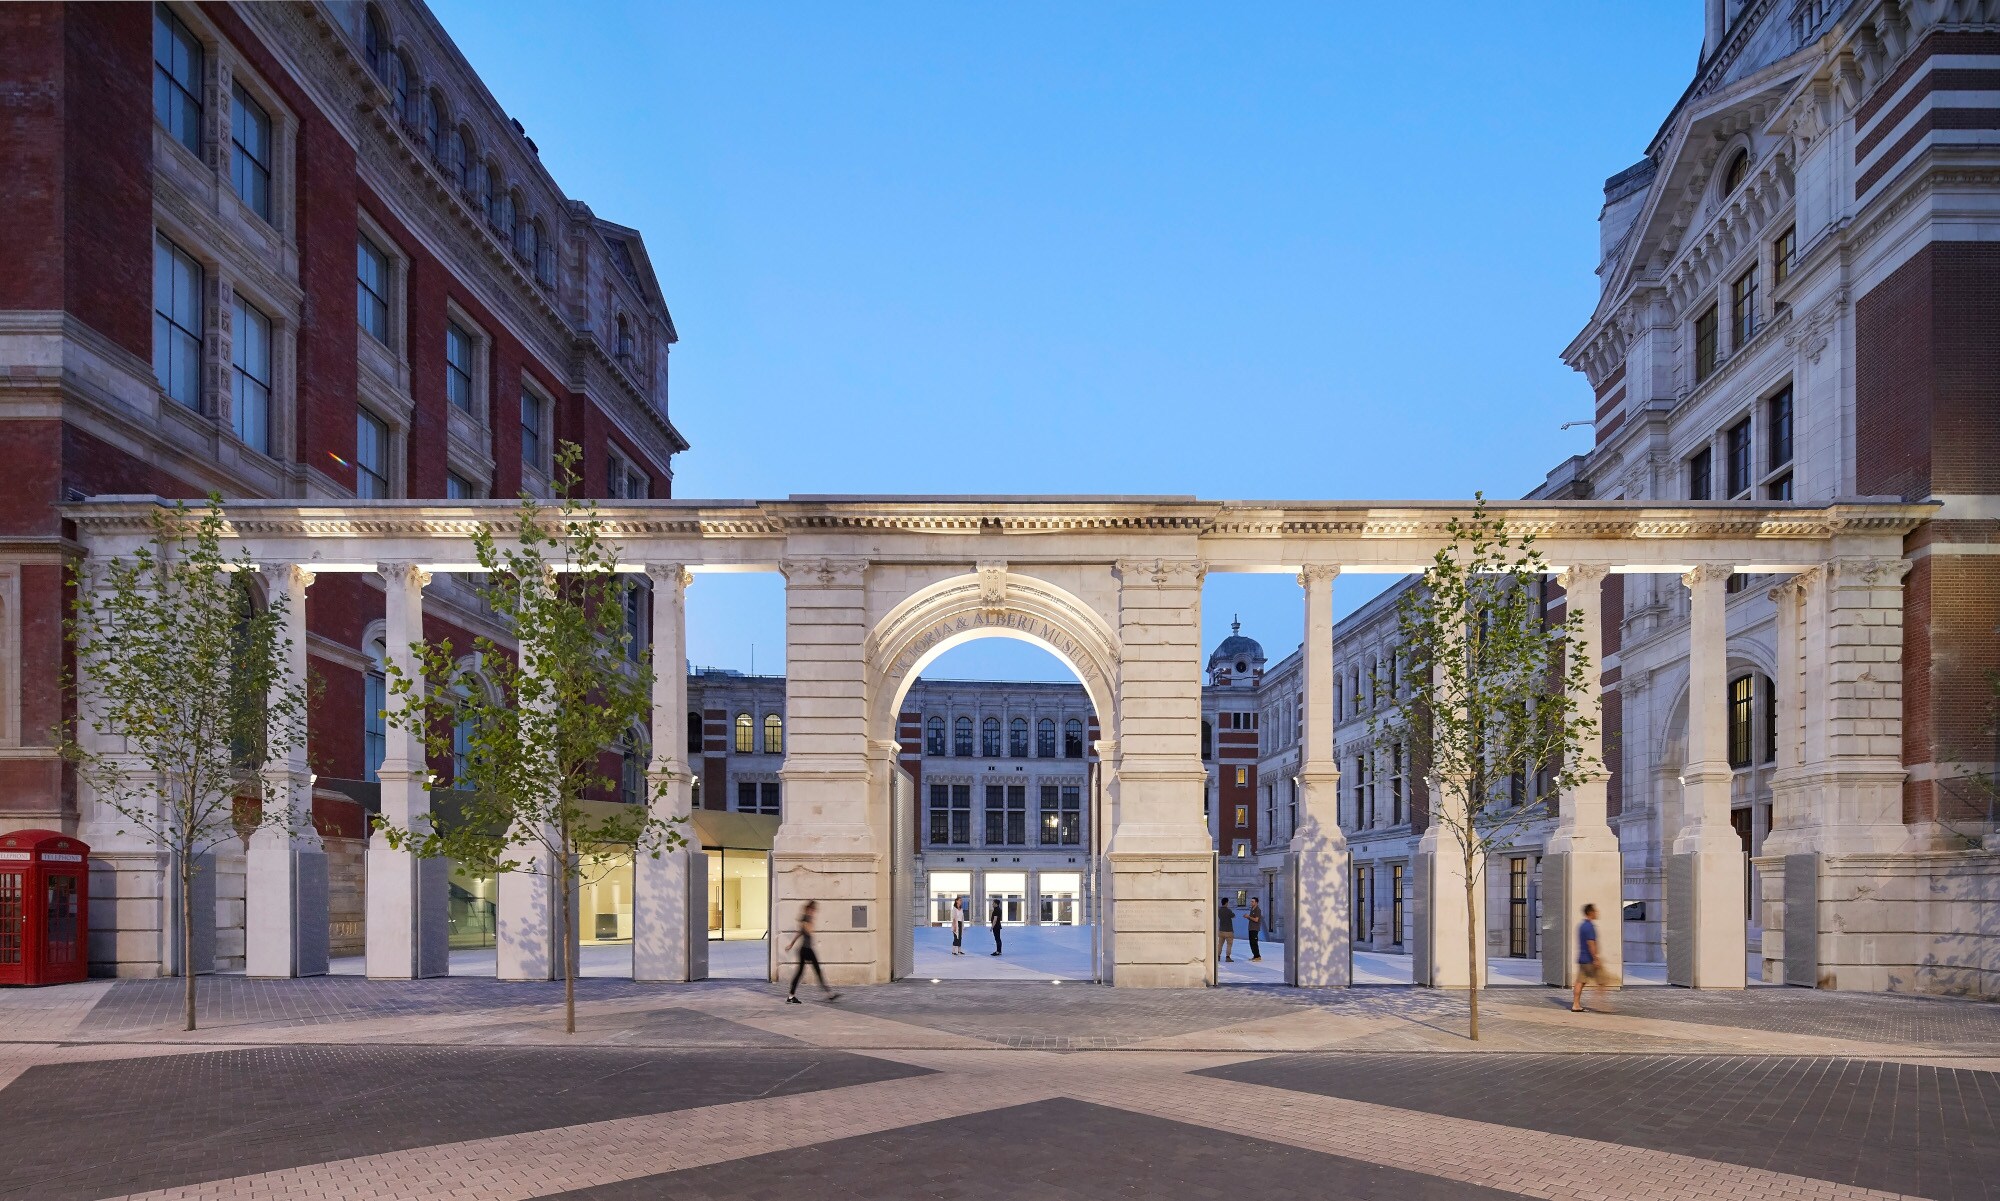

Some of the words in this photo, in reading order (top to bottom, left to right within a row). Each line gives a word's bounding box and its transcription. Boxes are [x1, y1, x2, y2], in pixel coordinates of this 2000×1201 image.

[890, 622, 953, 679] VICTORIA
[955, 616, 970, 630] &
[973, 612, 1038, 631] ALBERT
[1040, 623, 1099, 683] MUSEUM
[44, 854, 80, 862] TELEPHONE
